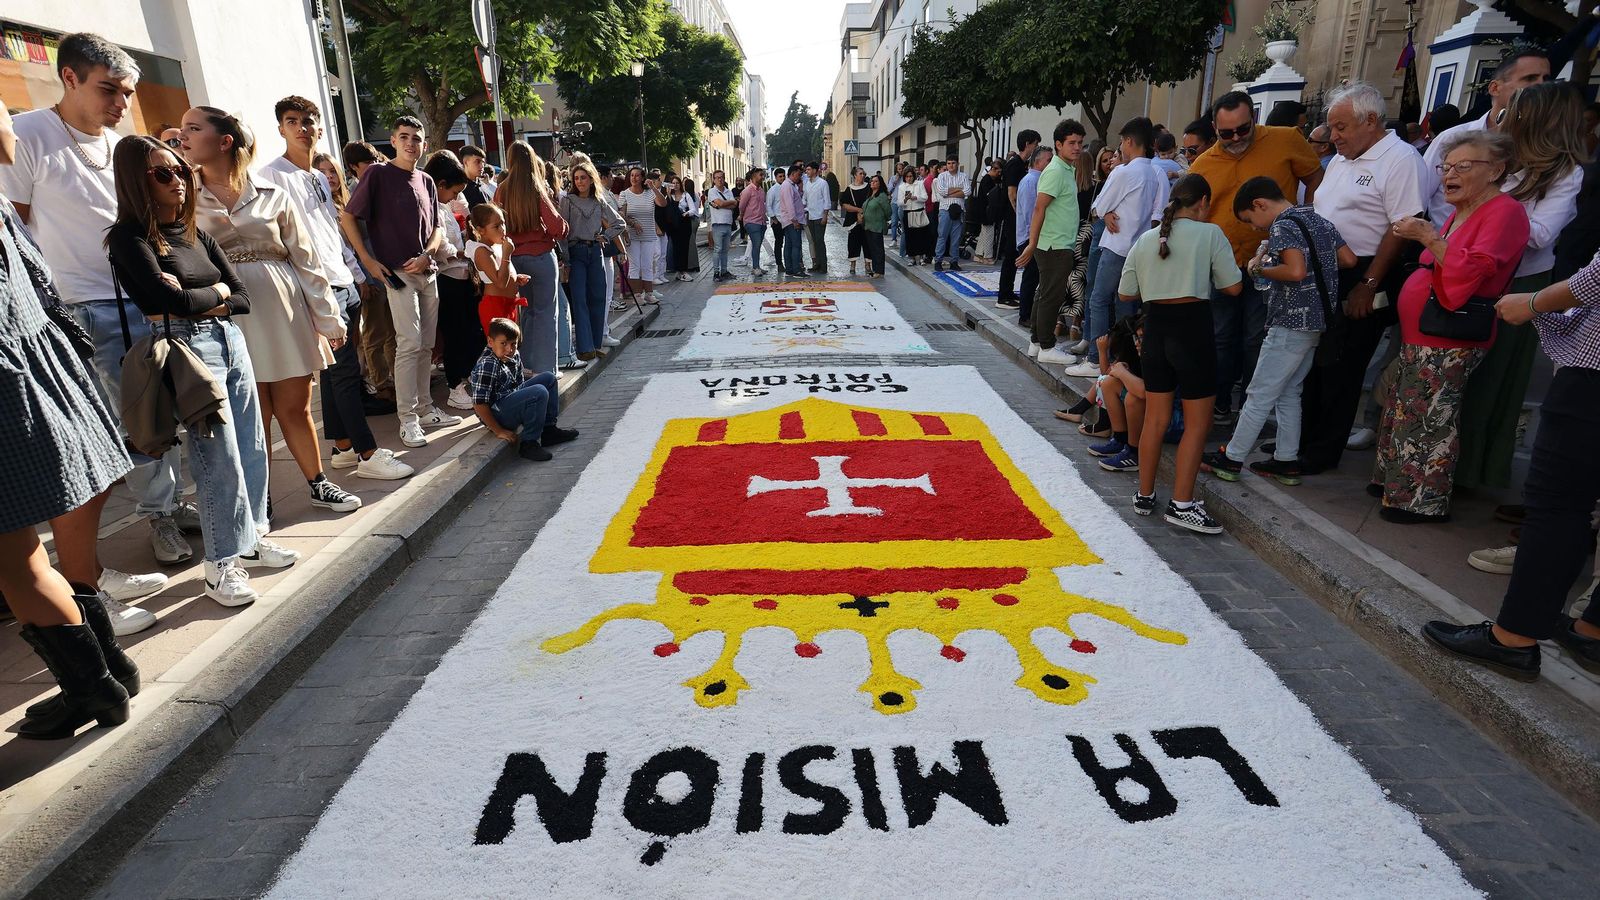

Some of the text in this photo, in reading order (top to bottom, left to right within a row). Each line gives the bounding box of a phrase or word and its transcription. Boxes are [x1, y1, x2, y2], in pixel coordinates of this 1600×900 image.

[700, 373, 893, 388] PATRONA
[708, 384, 909, 399] CON SU
[471, 726, 1281, 867] LA MISIÓN
